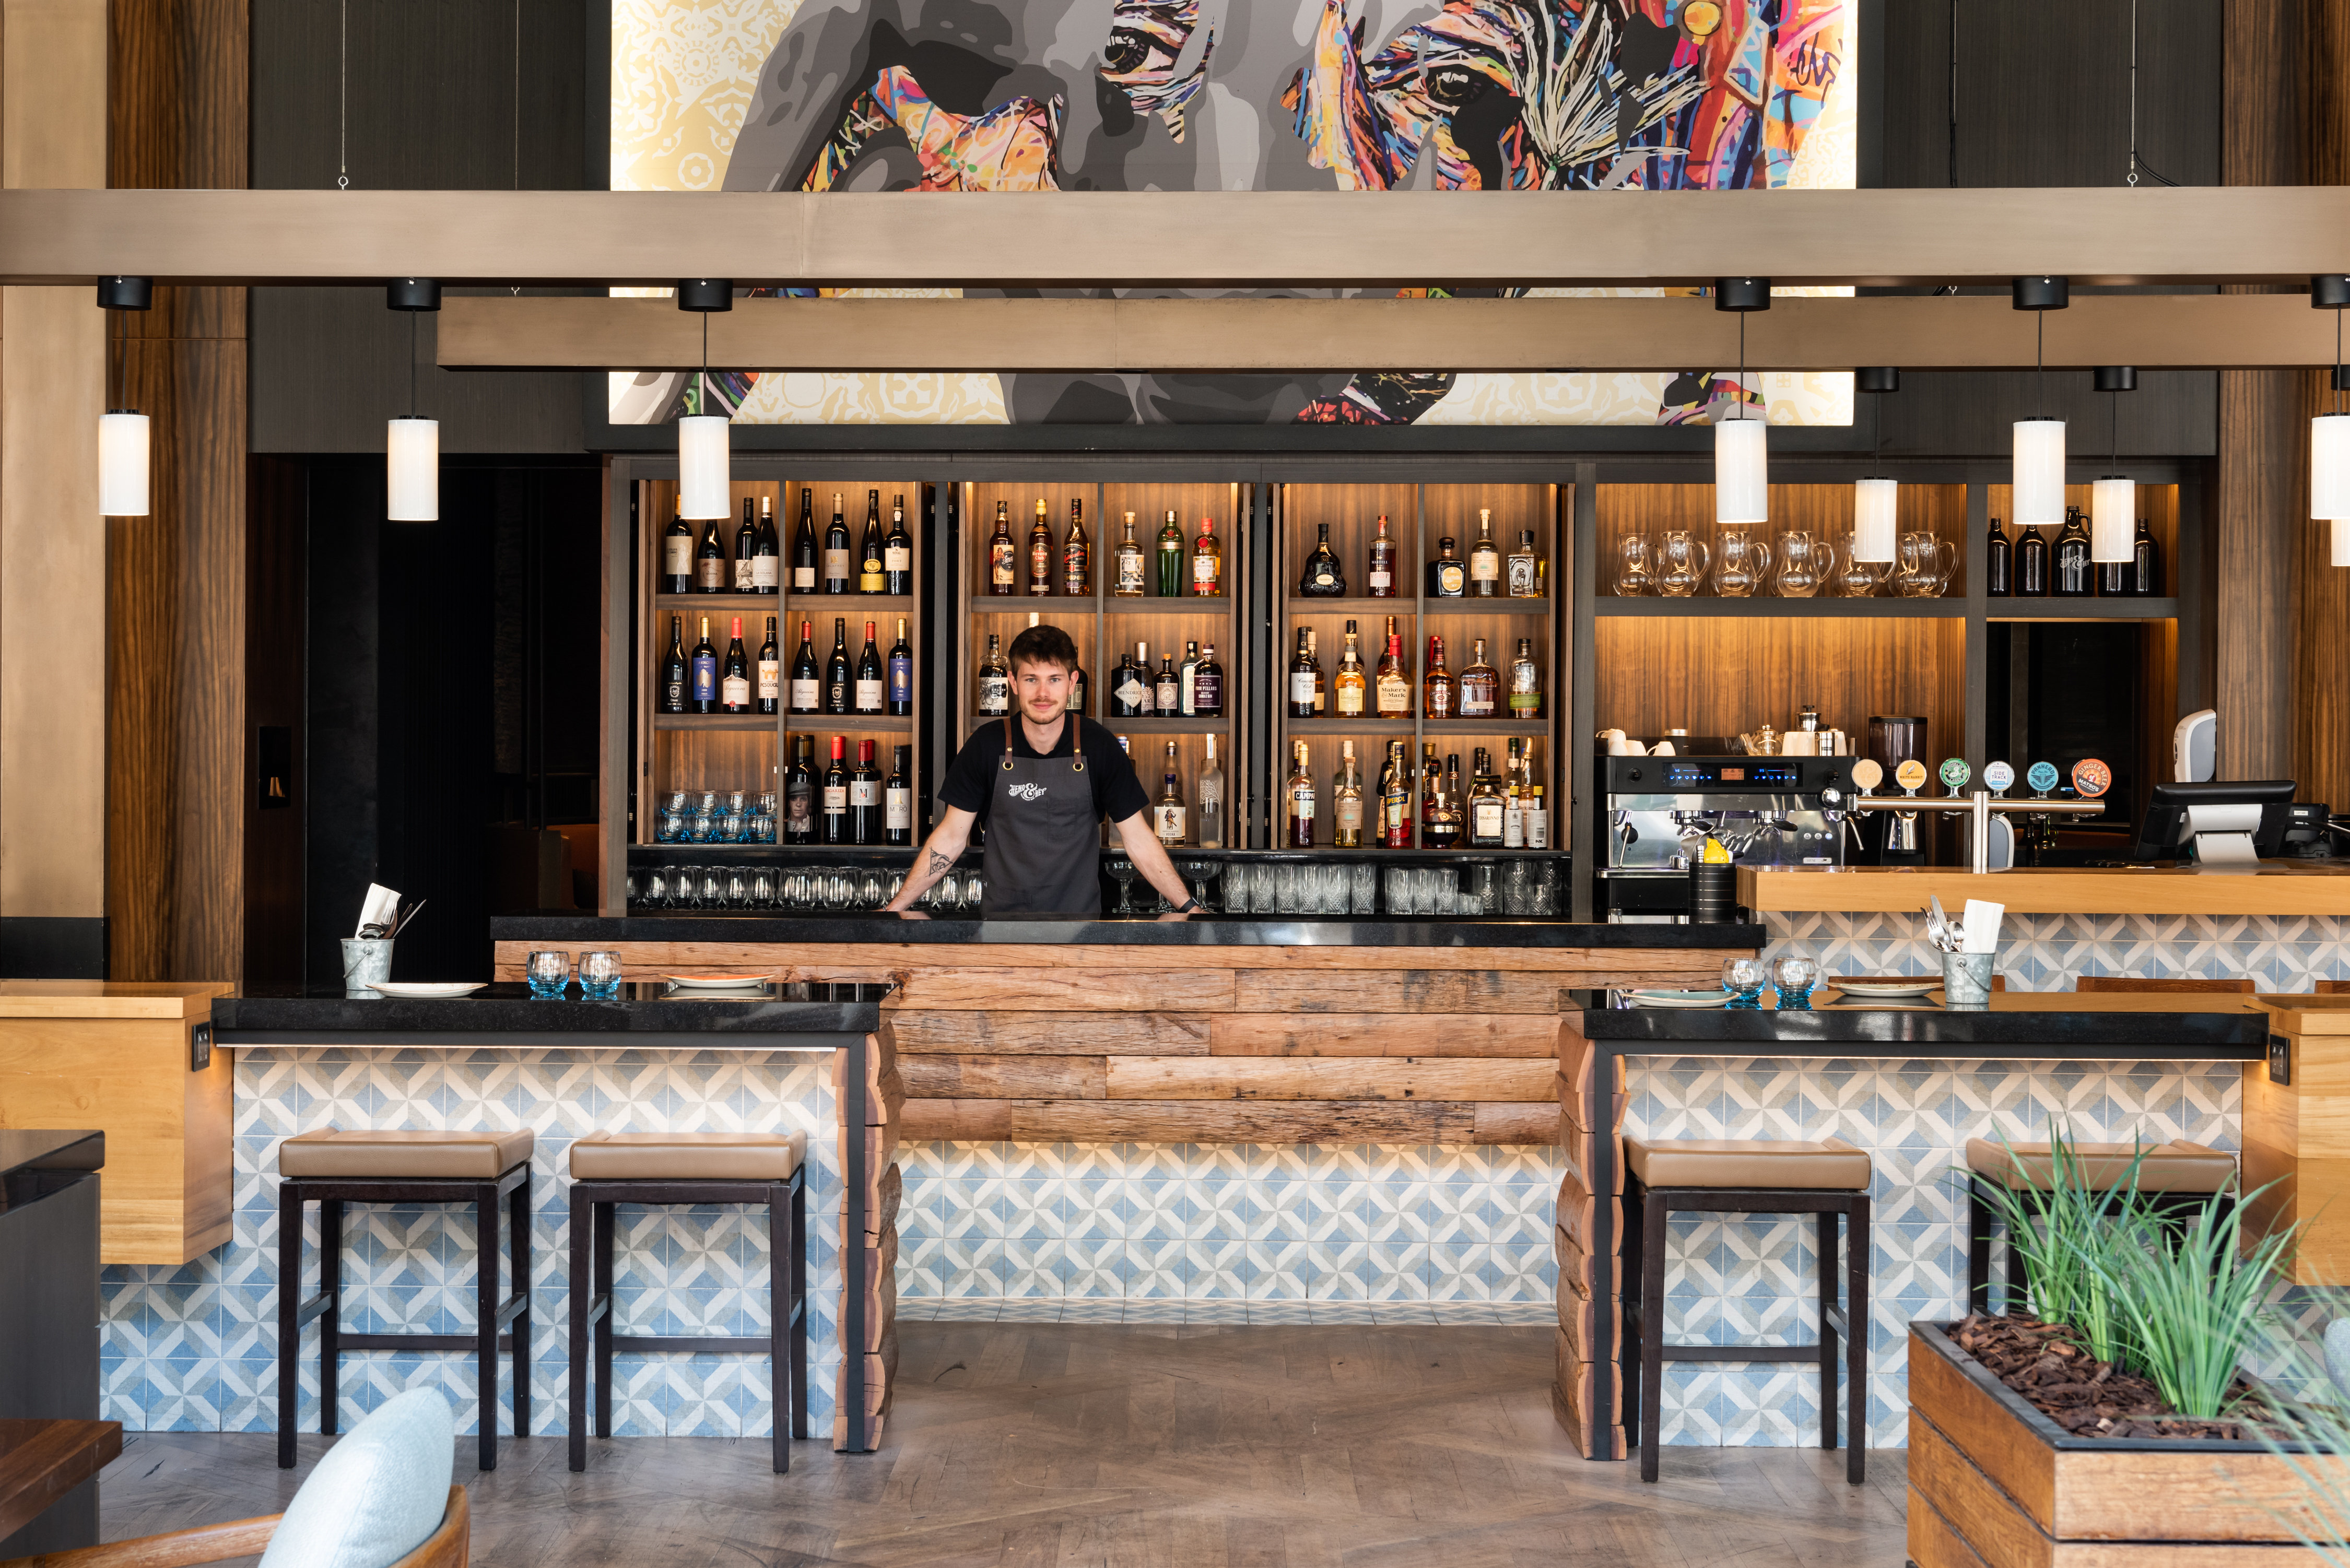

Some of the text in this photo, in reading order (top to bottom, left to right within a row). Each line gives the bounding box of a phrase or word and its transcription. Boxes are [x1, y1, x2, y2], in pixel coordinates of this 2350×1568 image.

[2031, 764, 2055, 774] PANHEAD
[2078, 763, 2101, 775] GINGER
[1009, 784, 1025, 796] HENO
[1023, 783, 1038, 799] &
[2078, 779, 2099, 792] MATSO'S
[1387, 796, 1405, 805] APEROL
